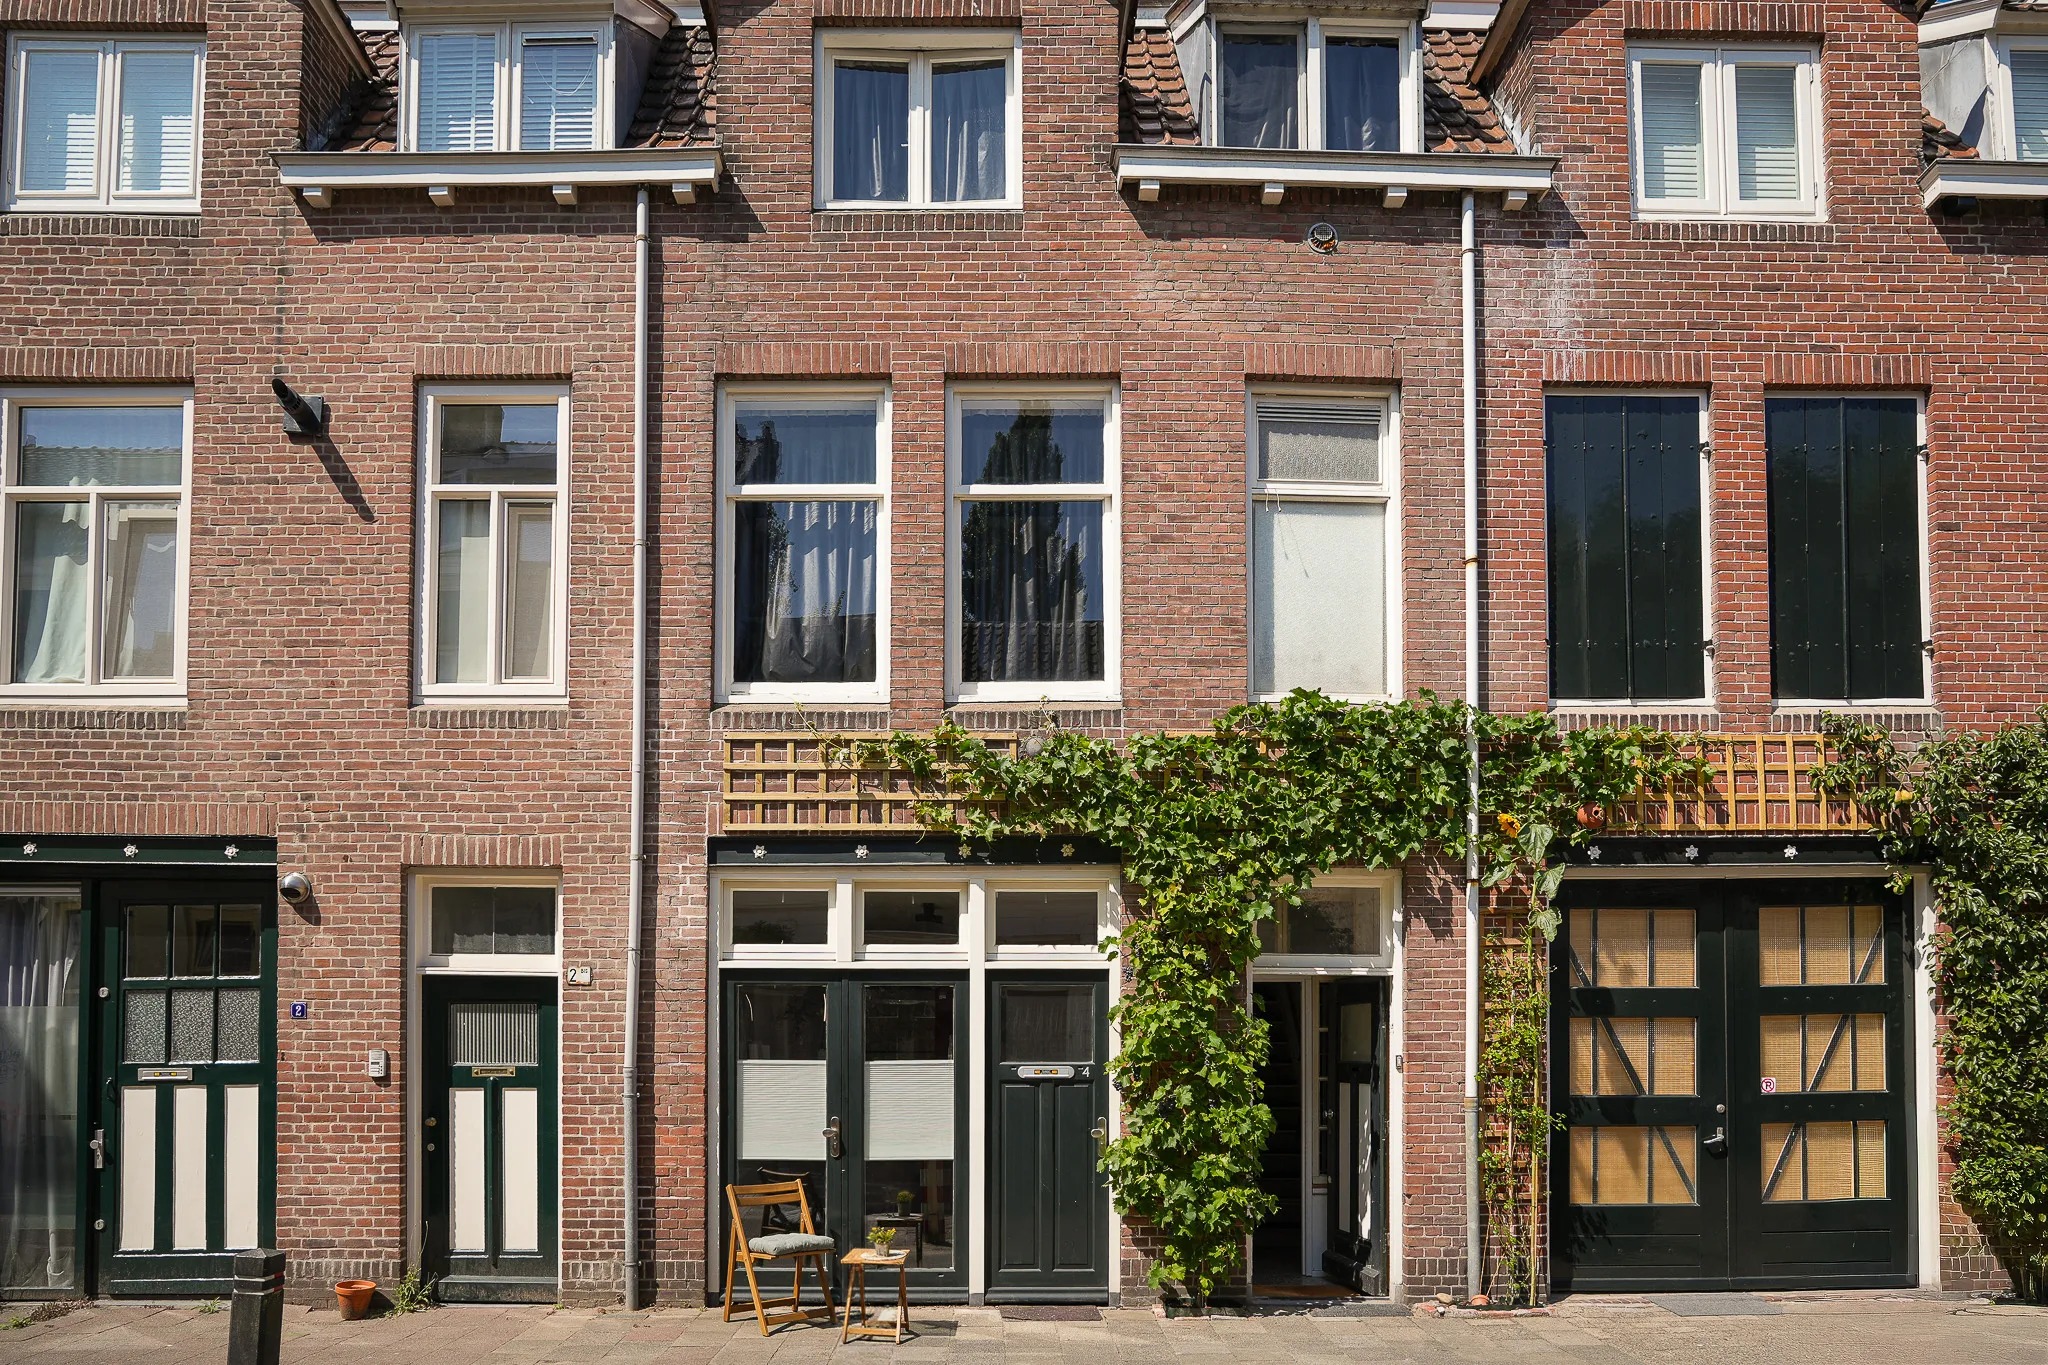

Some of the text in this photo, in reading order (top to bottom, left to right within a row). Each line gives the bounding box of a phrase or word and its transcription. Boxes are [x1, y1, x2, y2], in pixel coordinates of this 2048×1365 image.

[569, 968, 577, 982] 2
[295, 1005, 302, 1017] 2
[1081, 1066, 1090, 1078] 4
